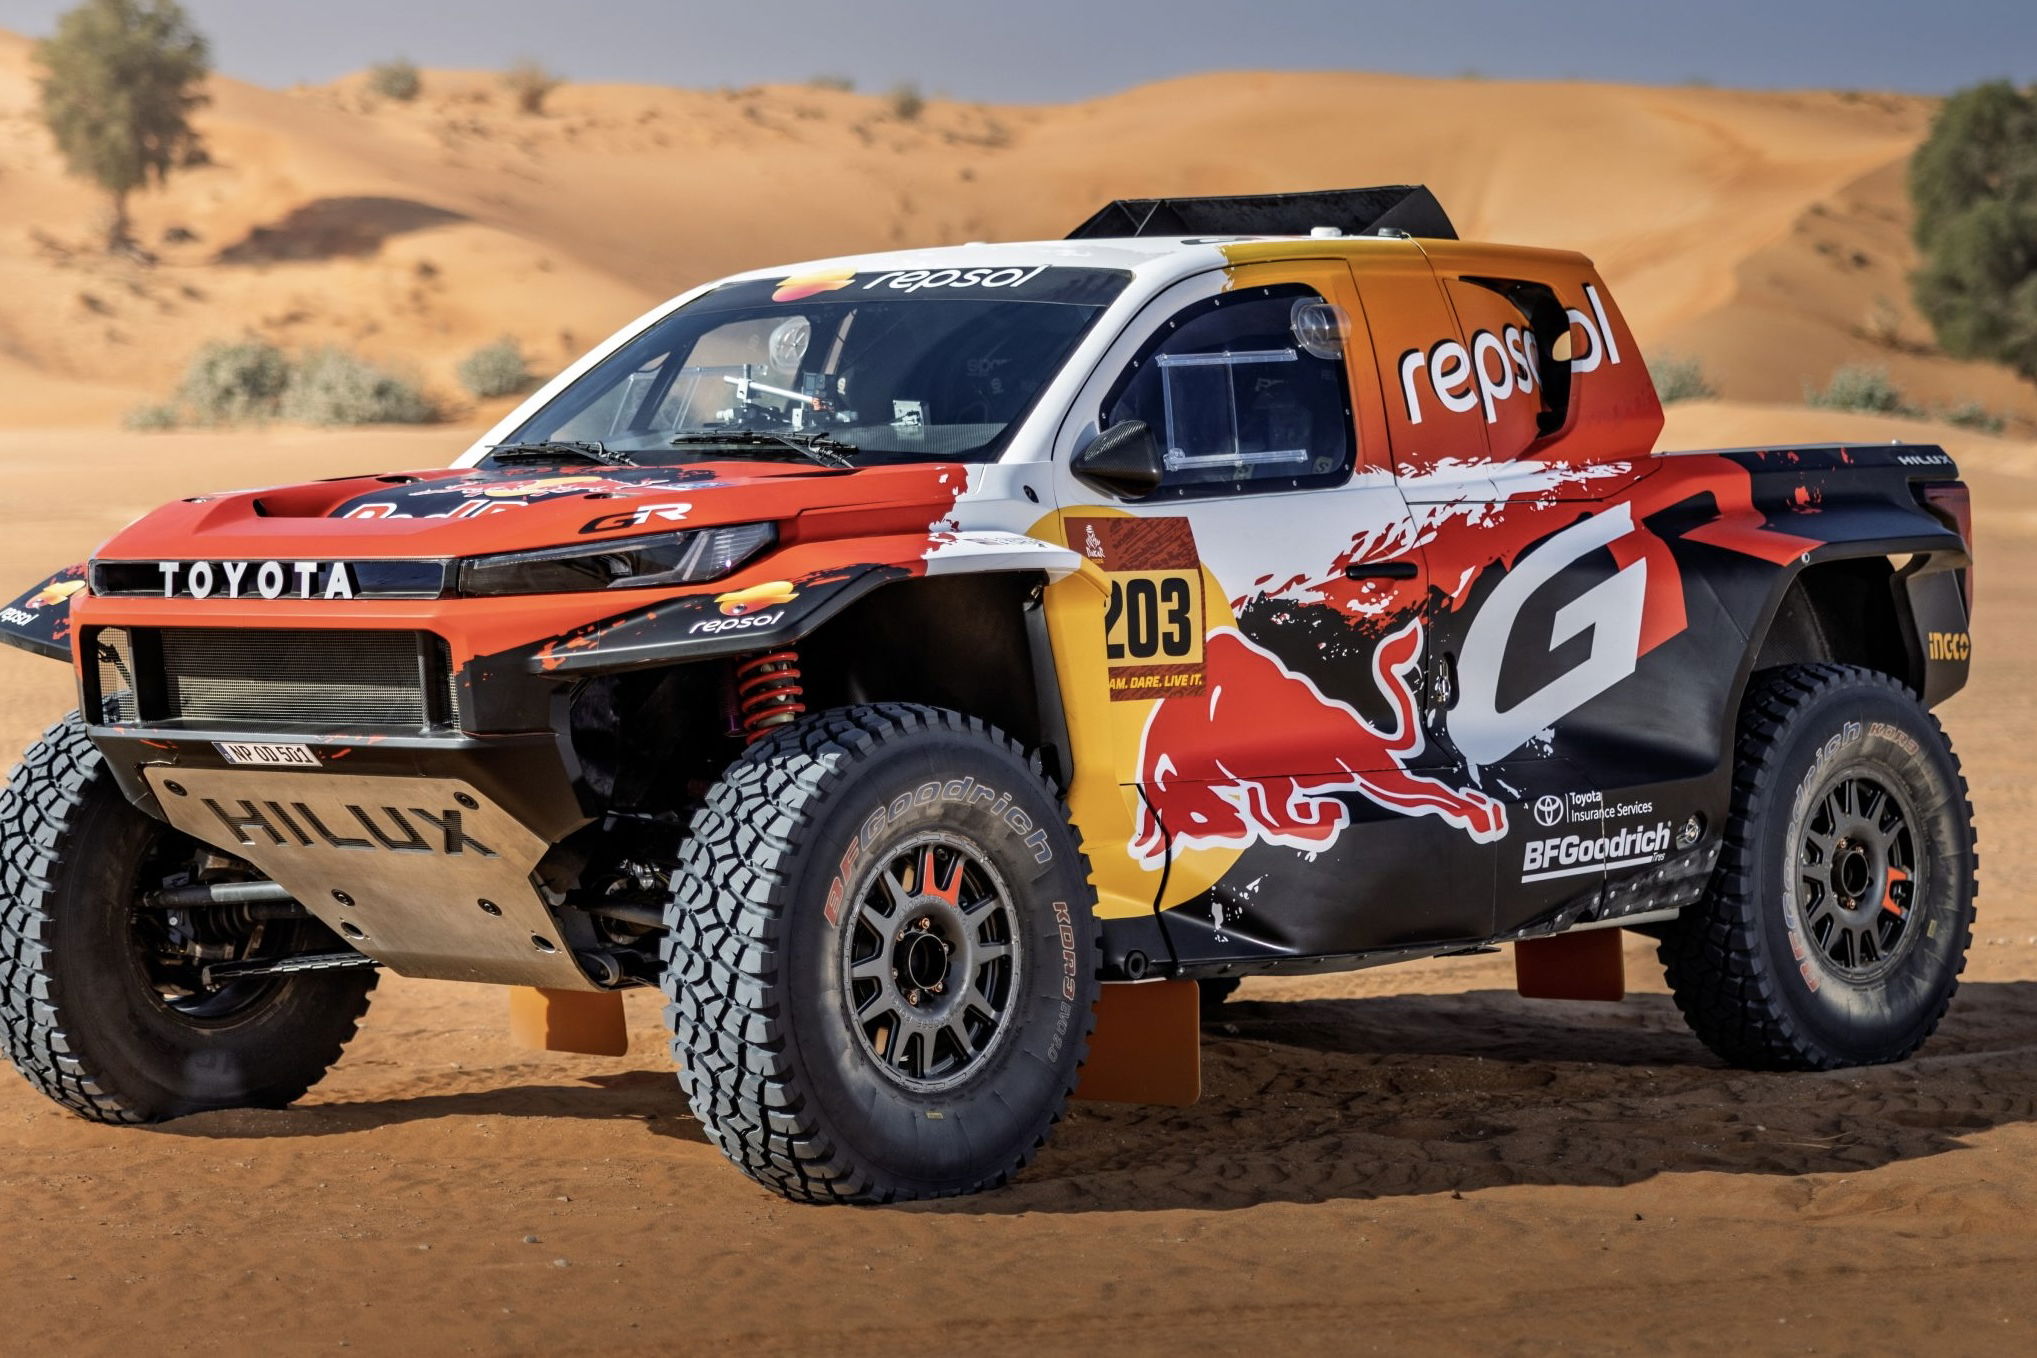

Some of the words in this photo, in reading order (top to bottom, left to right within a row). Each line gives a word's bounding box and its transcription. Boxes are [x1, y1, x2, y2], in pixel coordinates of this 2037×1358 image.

[862, 265, 1052, 293] repsol
[1400, 285, 1621, 425] repsol
[1897, 455, 1953, 466] HILUX
[578, 503, 693, 534] GR
[159, 561, 353, 599] TOYOTA
[0, 607, 39, 626] repsol
[688, 611, 785, 634] repsol
[1104, 577, 1191, 658] 203
[1130, 676, 1162, 689] DARE.
[1164, 674, 1189, 687] LIVE
[1189, 673, 1202, 686] IT.
[228, 745, 253, 761] NP
[253, 745, 280, 762] OD
[275, 746, 314, 763] 501
[1569, 790, 1602, 807] Toyota
[1571, 808, 1615, 823] Insurance
[1616, 801, 1653, 817] Services
[200, 798, 500, 857] HILUX
[1522, 821, 1671, 872] BFGoodrich
[823, 776, 1053, 928] BFGoodrich
[1052, 901, 1077, 1001] KDR3
